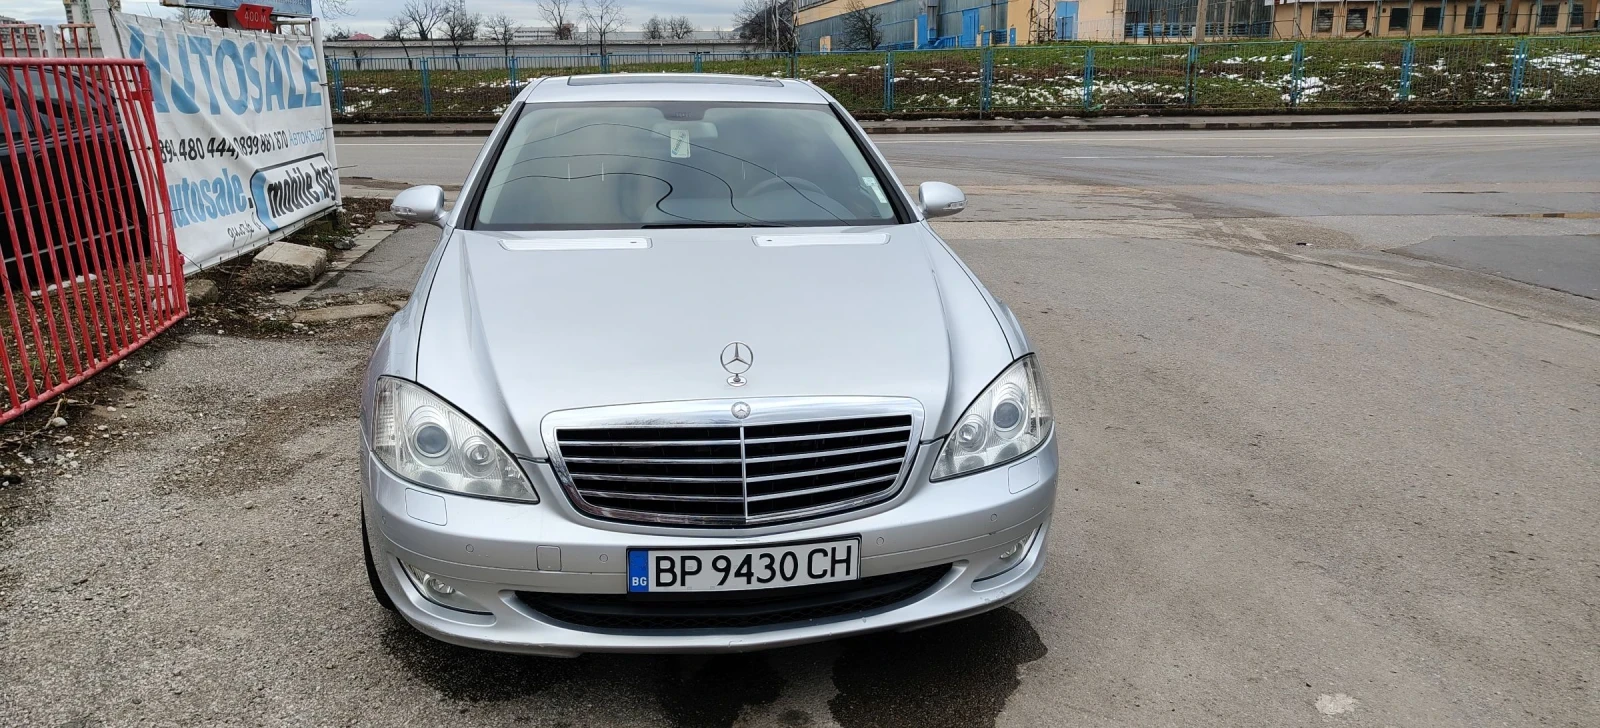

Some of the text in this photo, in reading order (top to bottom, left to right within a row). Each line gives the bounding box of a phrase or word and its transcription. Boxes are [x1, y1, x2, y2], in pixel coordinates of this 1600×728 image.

[244, 11, 259, 23] 400
[127, 24, 322, 115] AUTOSALE
[159, 139, 179, 163] 894
[179, 137, 205, 161] 480
[260, 135, 276, 152] 881
[276, 130, 289, 148] 870
[267, 163, 336, 218] mobile.bg
[632, 545, 852, 588] BG BP 9430 CH
